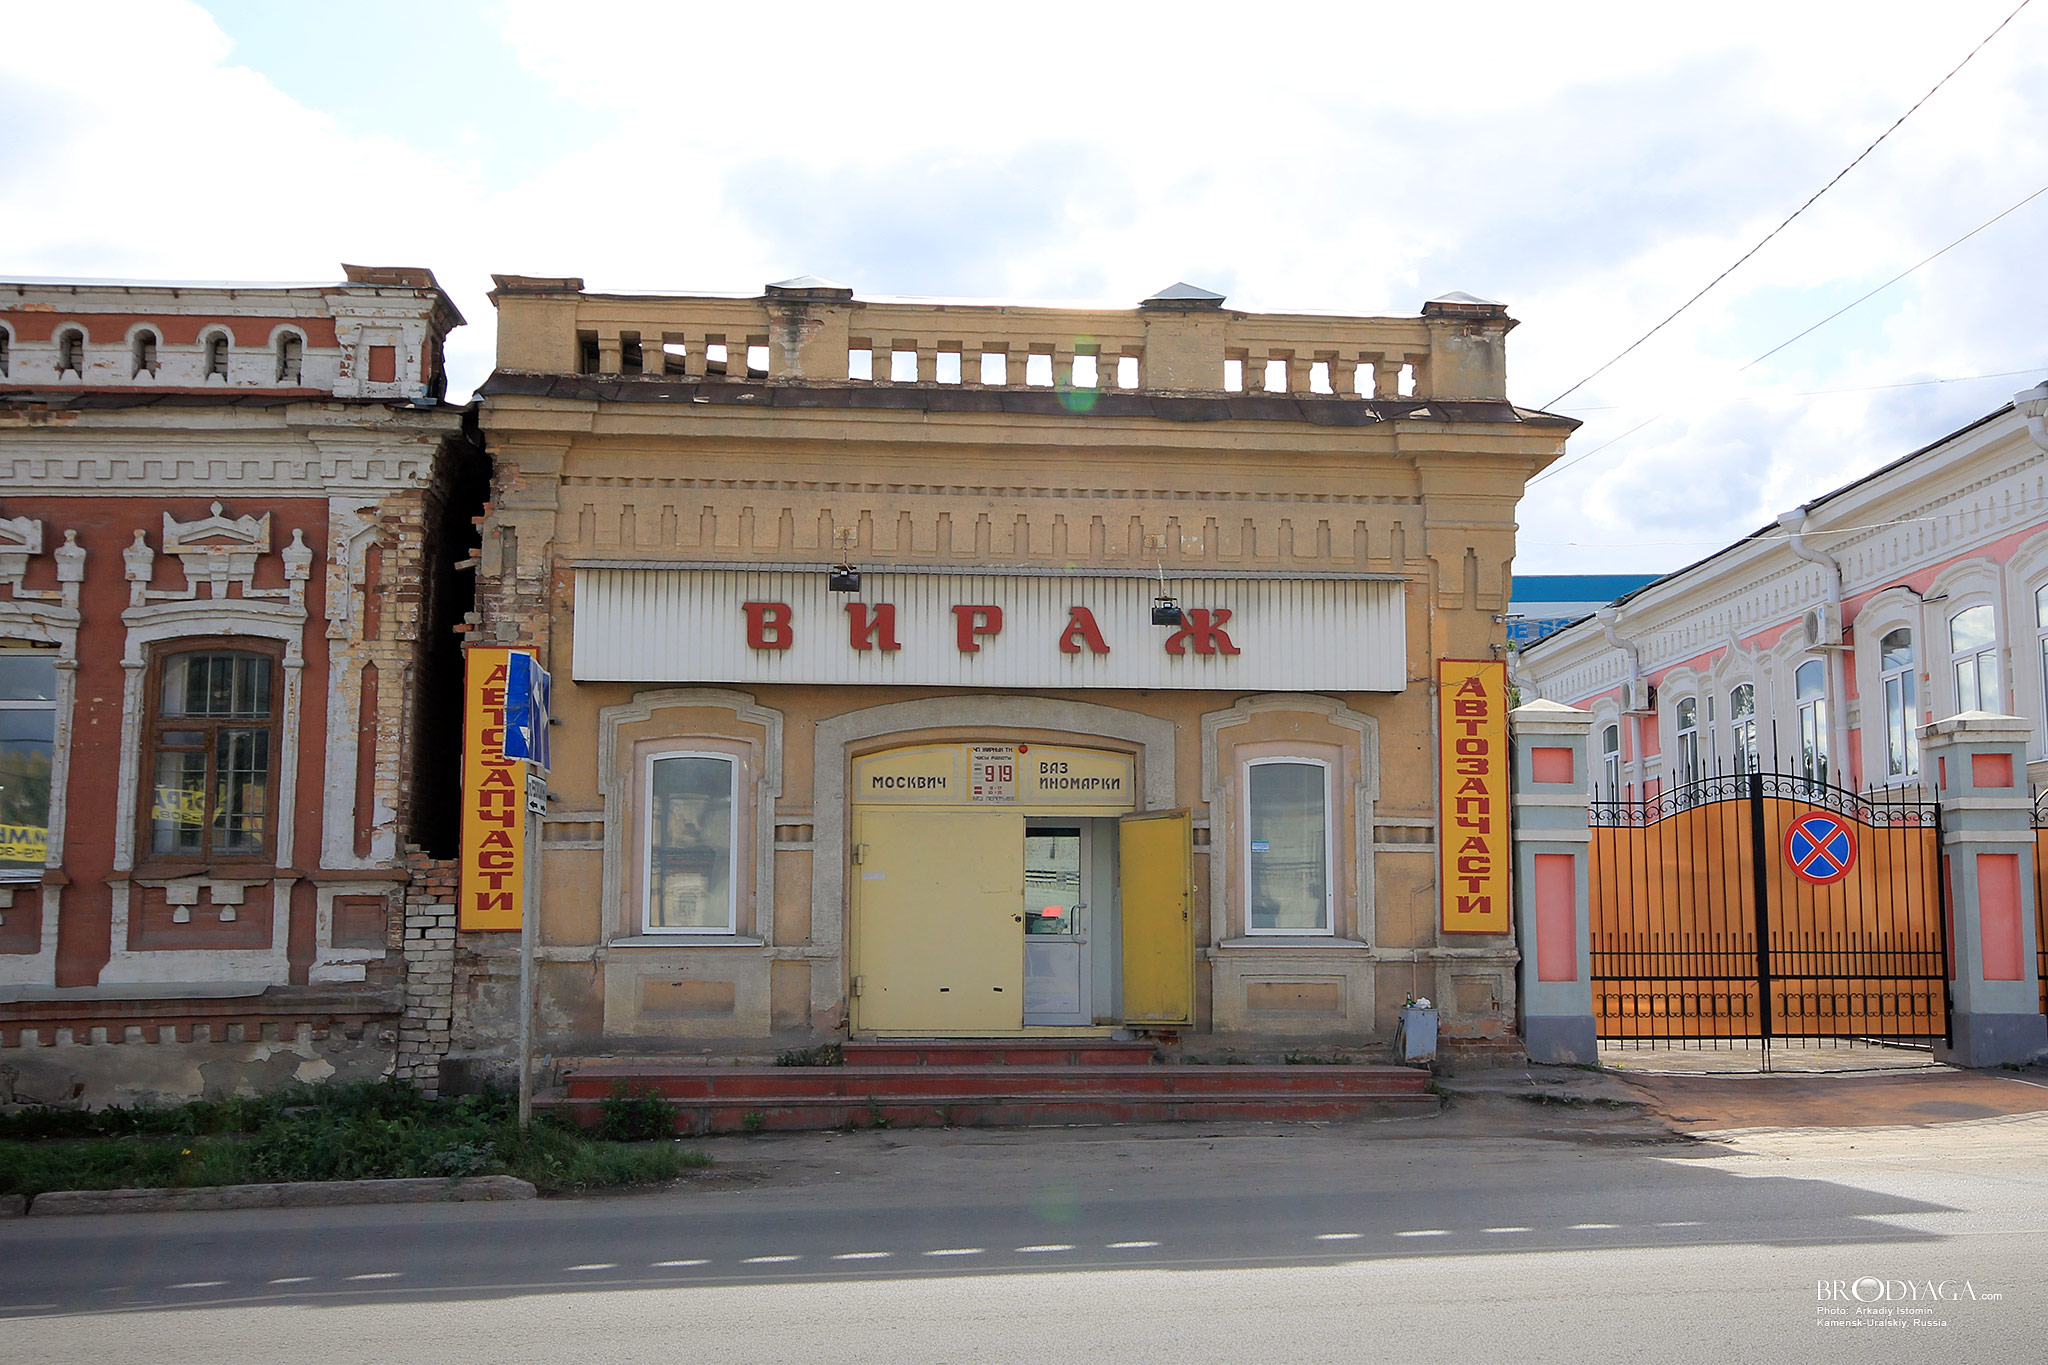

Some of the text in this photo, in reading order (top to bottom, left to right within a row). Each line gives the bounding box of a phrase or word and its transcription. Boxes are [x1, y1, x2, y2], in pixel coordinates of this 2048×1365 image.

[741, 601, 1241, 655] ВИРАЖ
[1039, 762, 1069, 774] ВАЗ
[872, 776, 947, 789] МОСКВИЧ
[1039, 777, 1121, 790] ИНОМАРКИ
[1453, 677, 1492, 914] АВТОЗАПЧАСТИ
